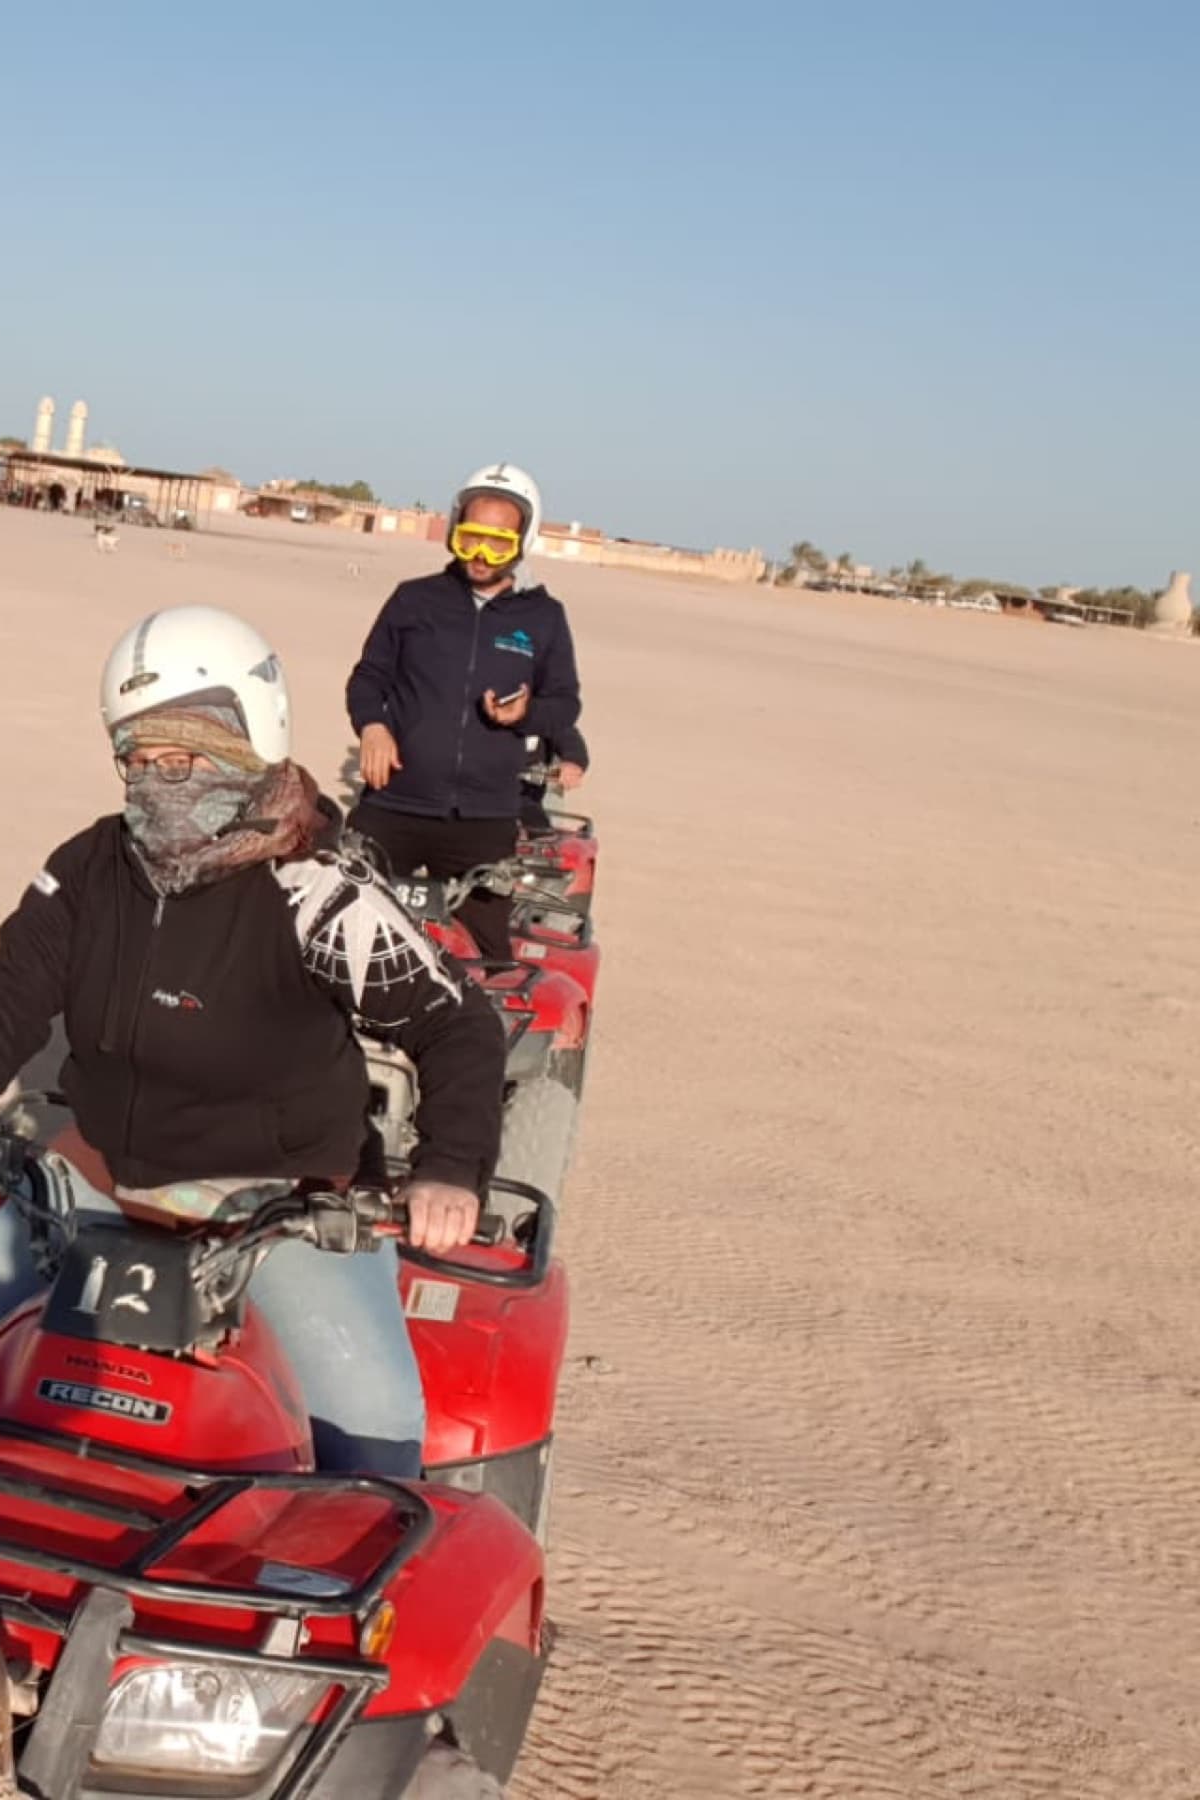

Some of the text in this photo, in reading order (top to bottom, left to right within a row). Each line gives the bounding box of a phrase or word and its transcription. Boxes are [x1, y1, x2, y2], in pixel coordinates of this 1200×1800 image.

[72, 1256, 156, 1314] 12
[65, 1354, 150, 1383] HONDA
[49, 1382, 158, 1419] RECON
